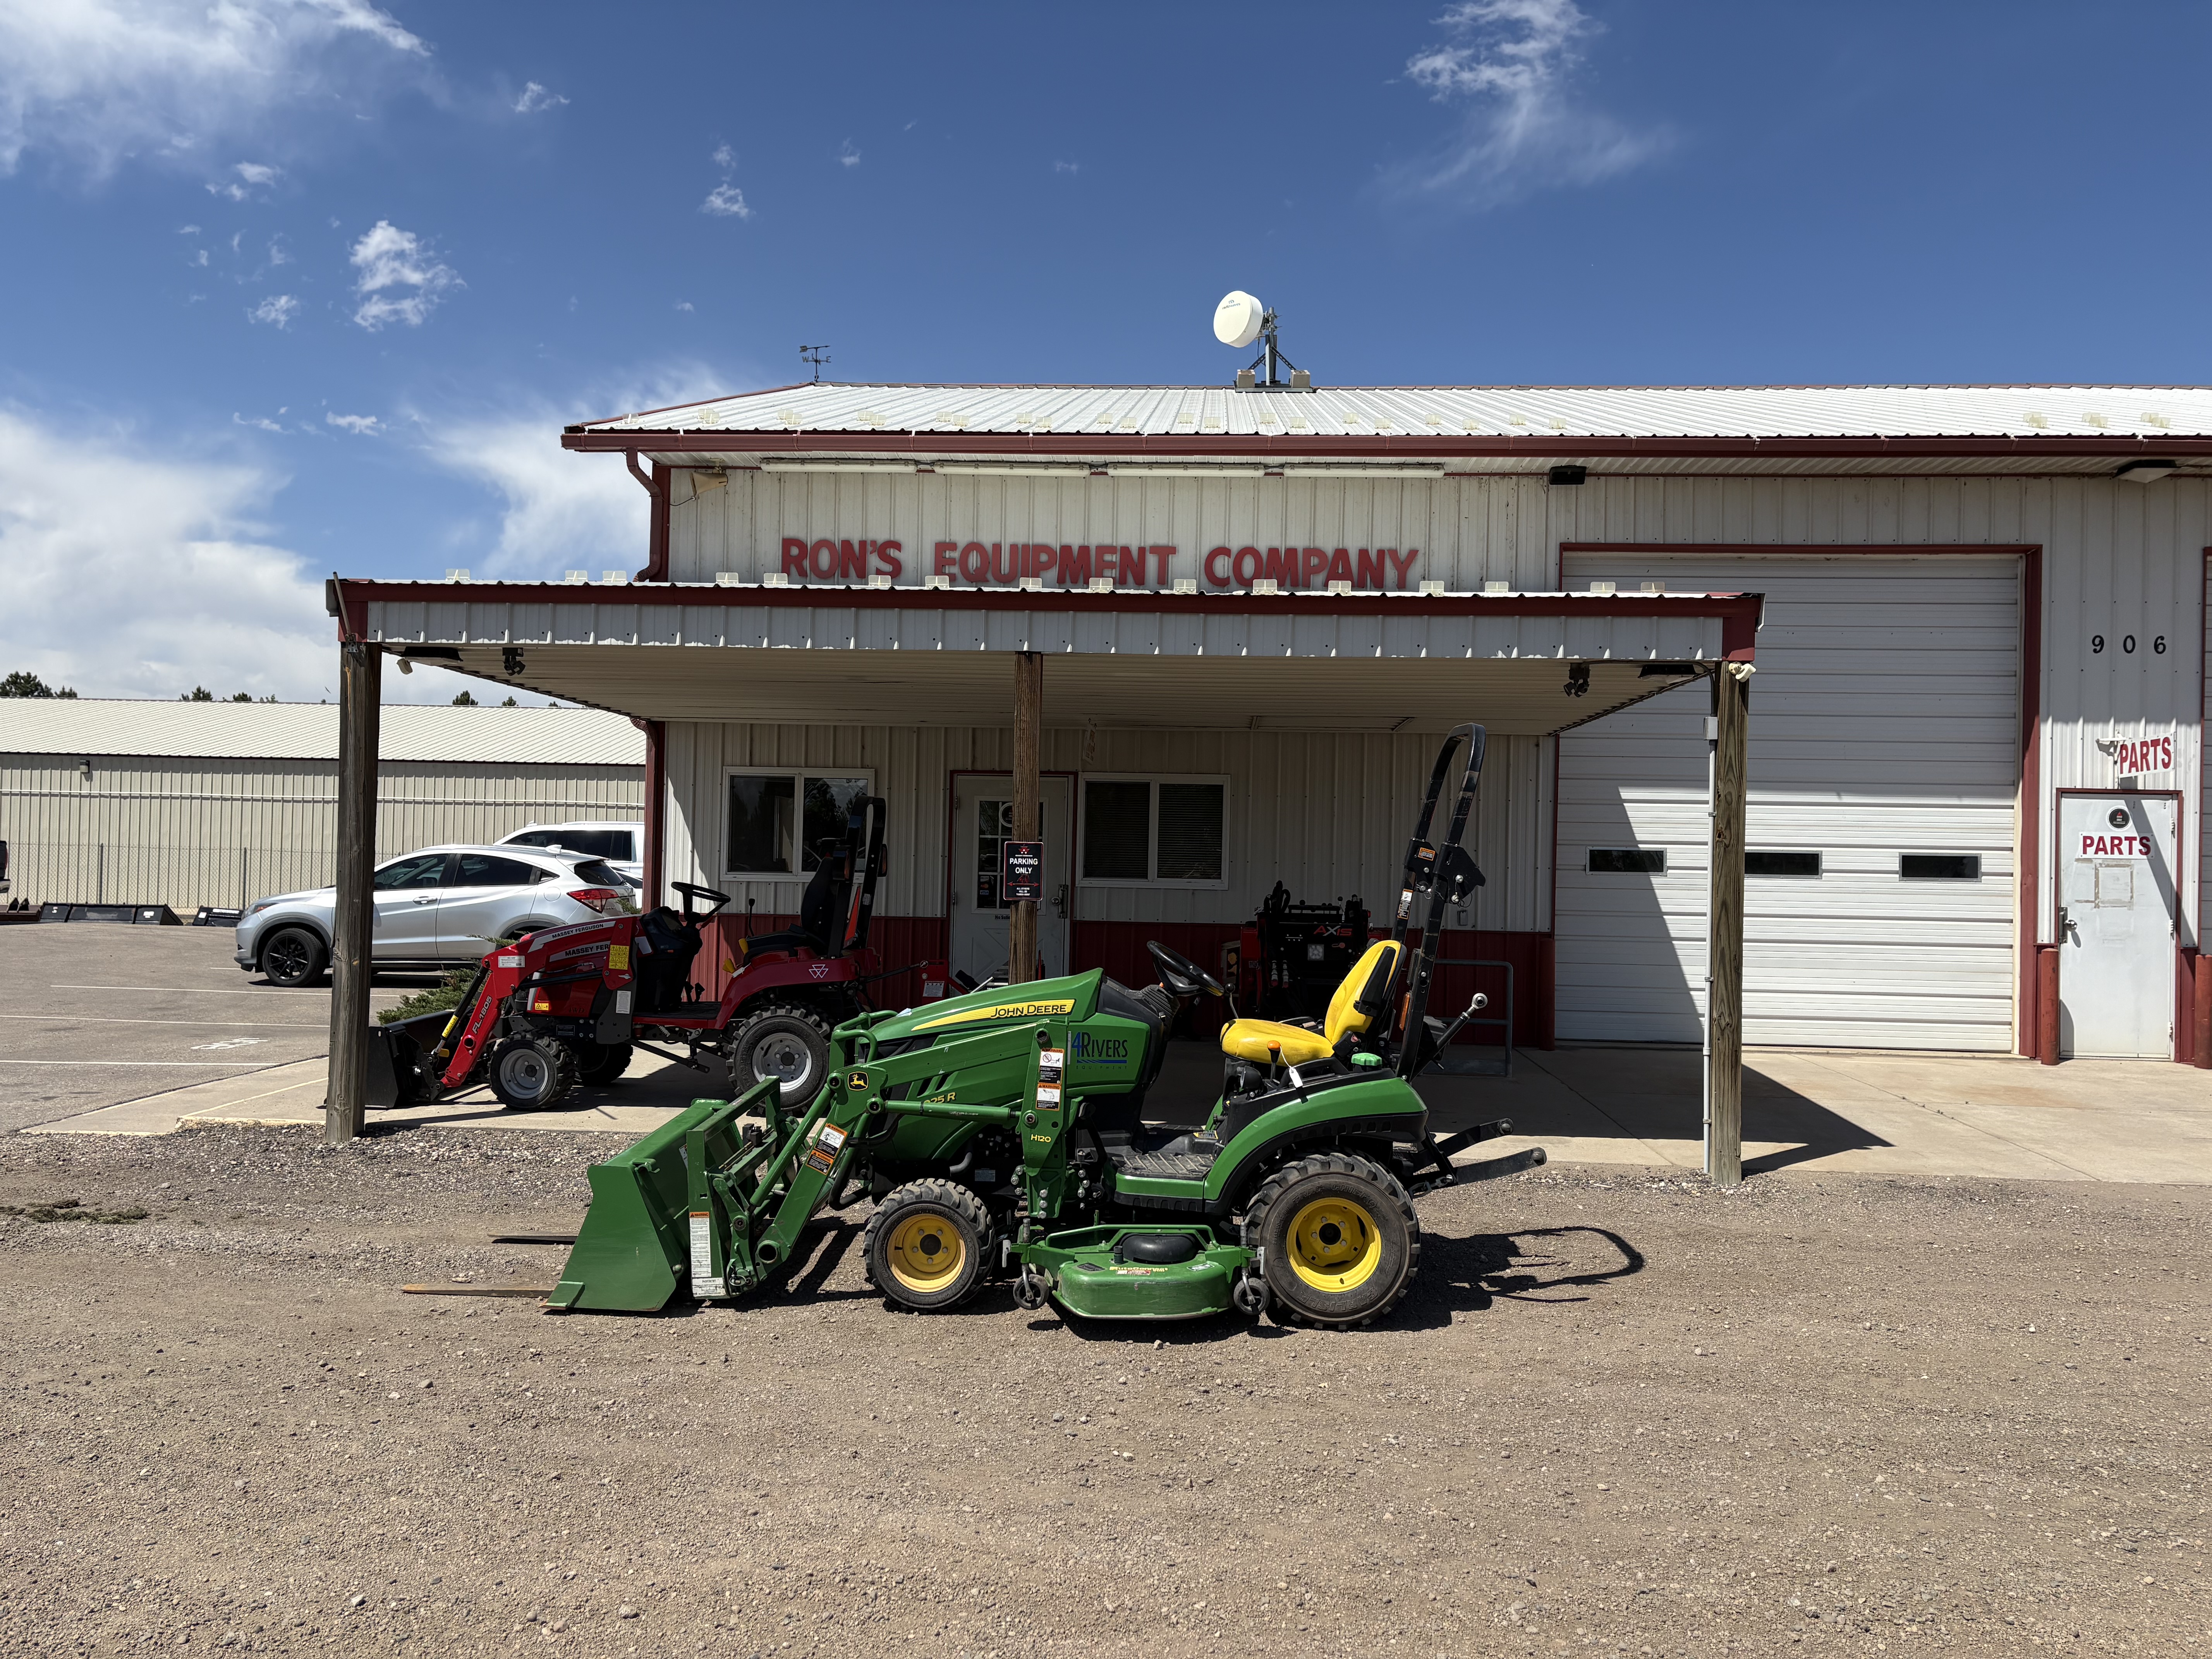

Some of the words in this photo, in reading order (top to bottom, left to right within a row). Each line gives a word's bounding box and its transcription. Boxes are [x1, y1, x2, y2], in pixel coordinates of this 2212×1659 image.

[781, 538, 902, 579] RON'S
[934, 542, 1176, 585] EQUIPMENT
[1204, 547, 1419, 589] COMPANY
[2092, 635, 2166, 654] 906
[2119, 737, 2172, 774] PARTS
[2083, 836, 2151, 855] PARTS
[1313, 925, 1353, 936] AXIS
[565, 946, 594, 957] MASSEY
[991, 1007, 1024, 1018] JOHN
[1027, 1005, 1067, 1015] DEERE
[1031, 1133, 1051, 1142] H120
[1296, 1286, 1378, 1312] CARLISLE
